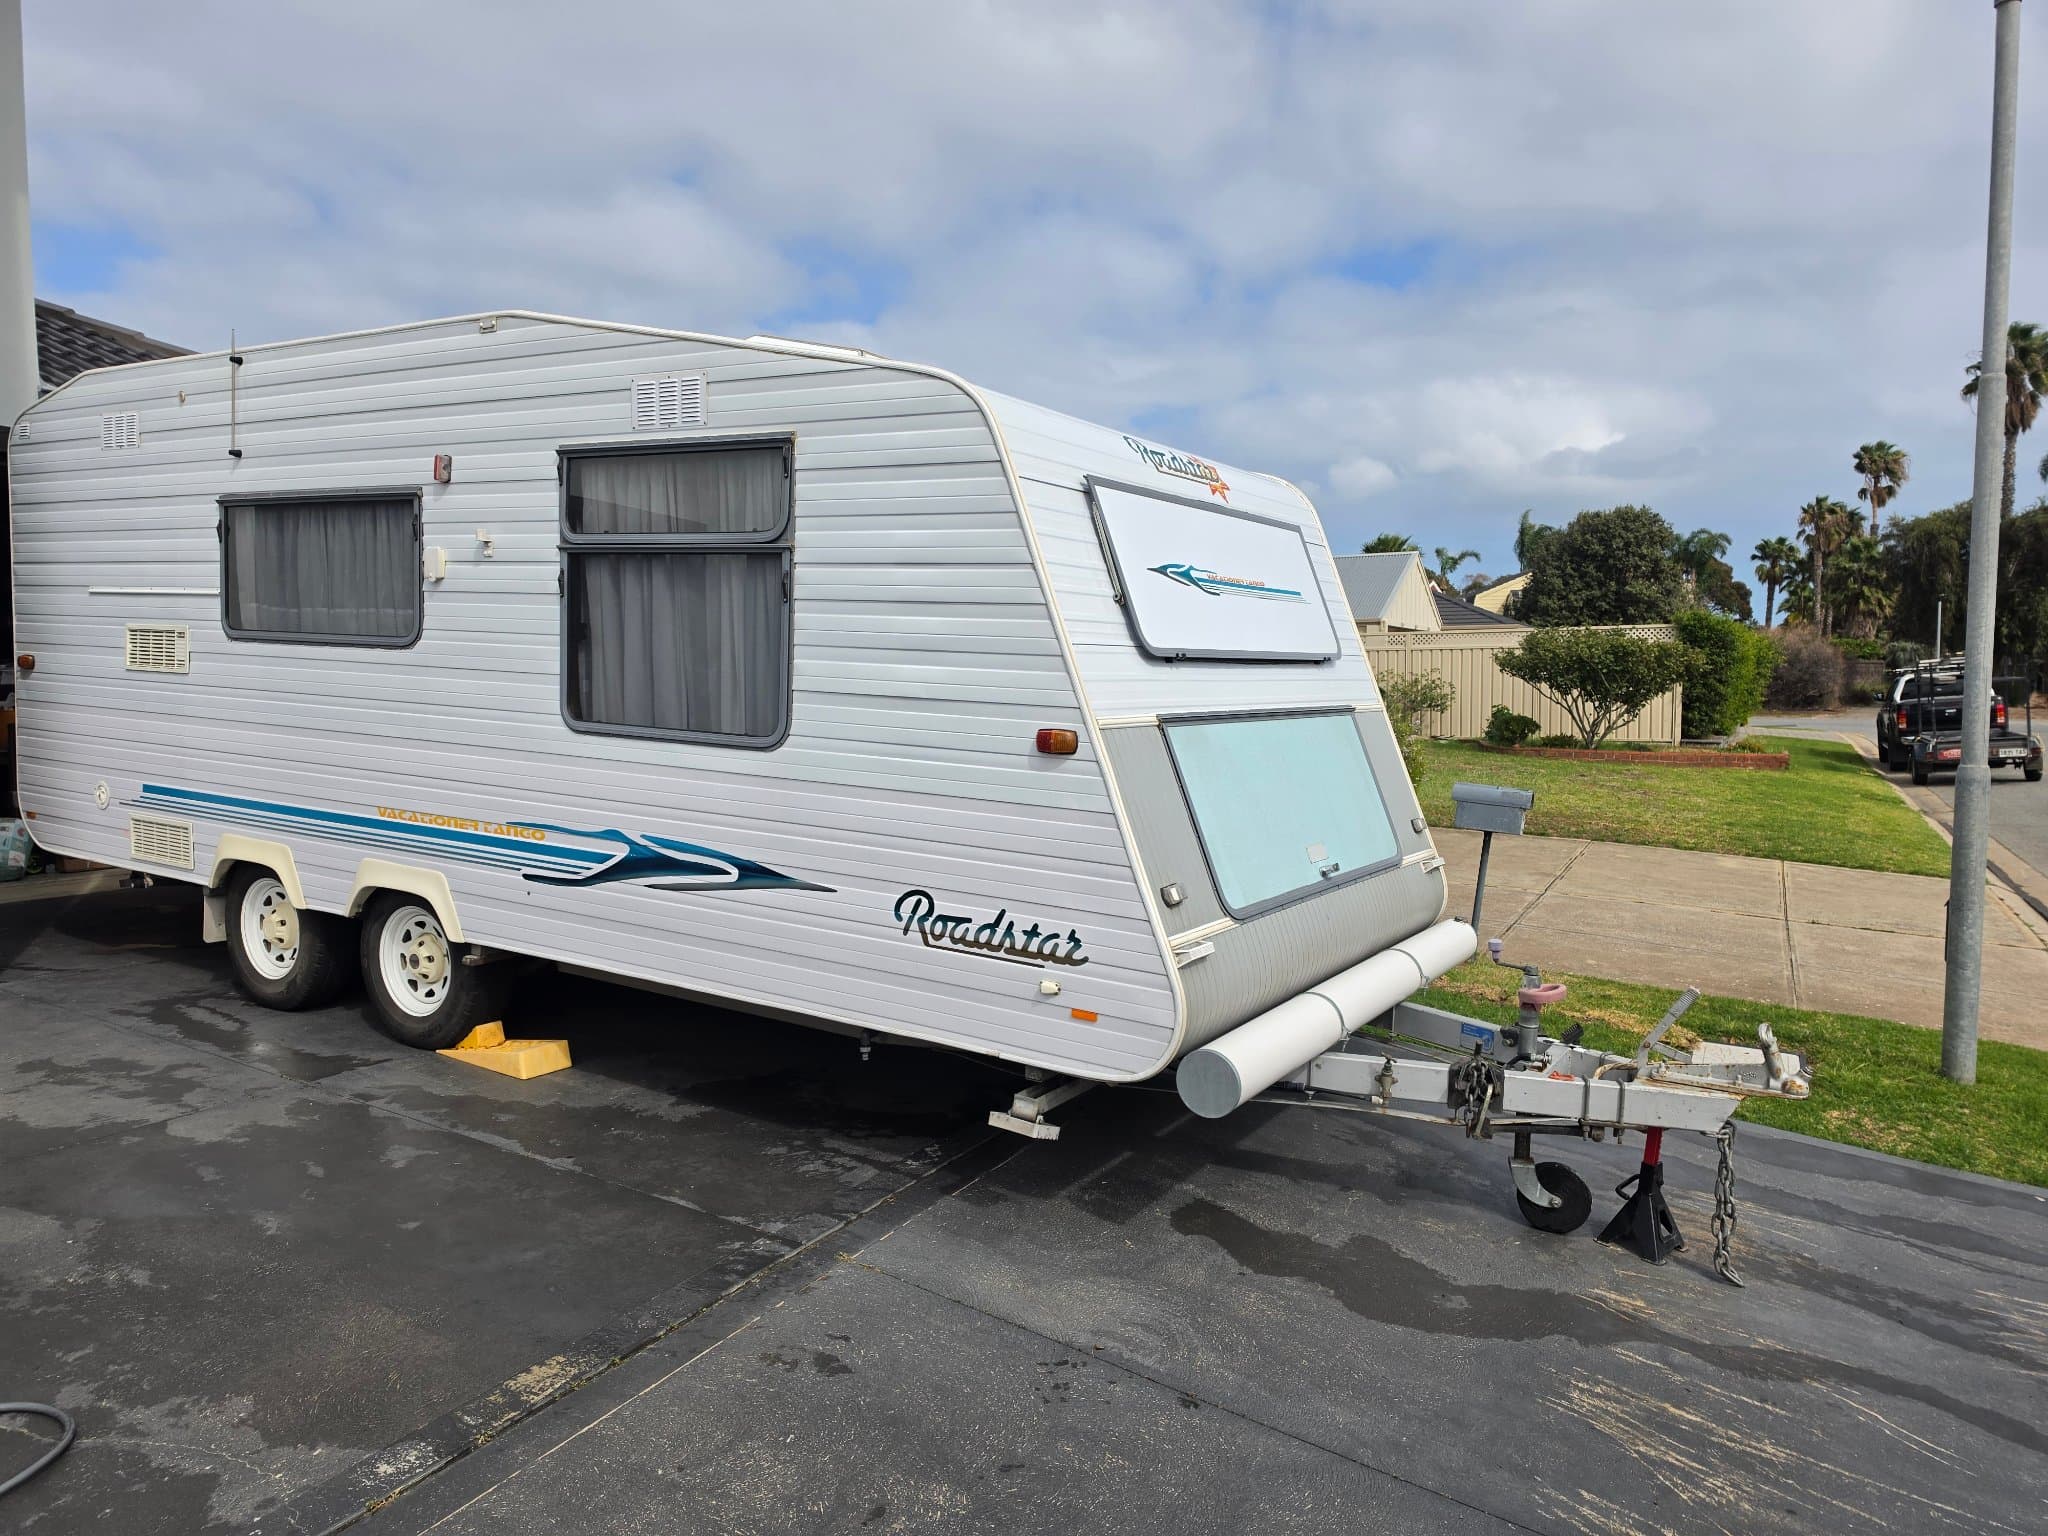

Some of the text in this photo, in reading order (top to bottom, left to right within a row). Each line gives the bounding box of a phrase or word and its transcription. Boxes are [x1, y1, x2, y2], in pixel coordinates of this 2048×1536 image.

[1122, 435, 1220, 486] Roadstar
[376, 805, 479, 832] VACATIONER
[894, 889, 1090, 968] Roadstar
